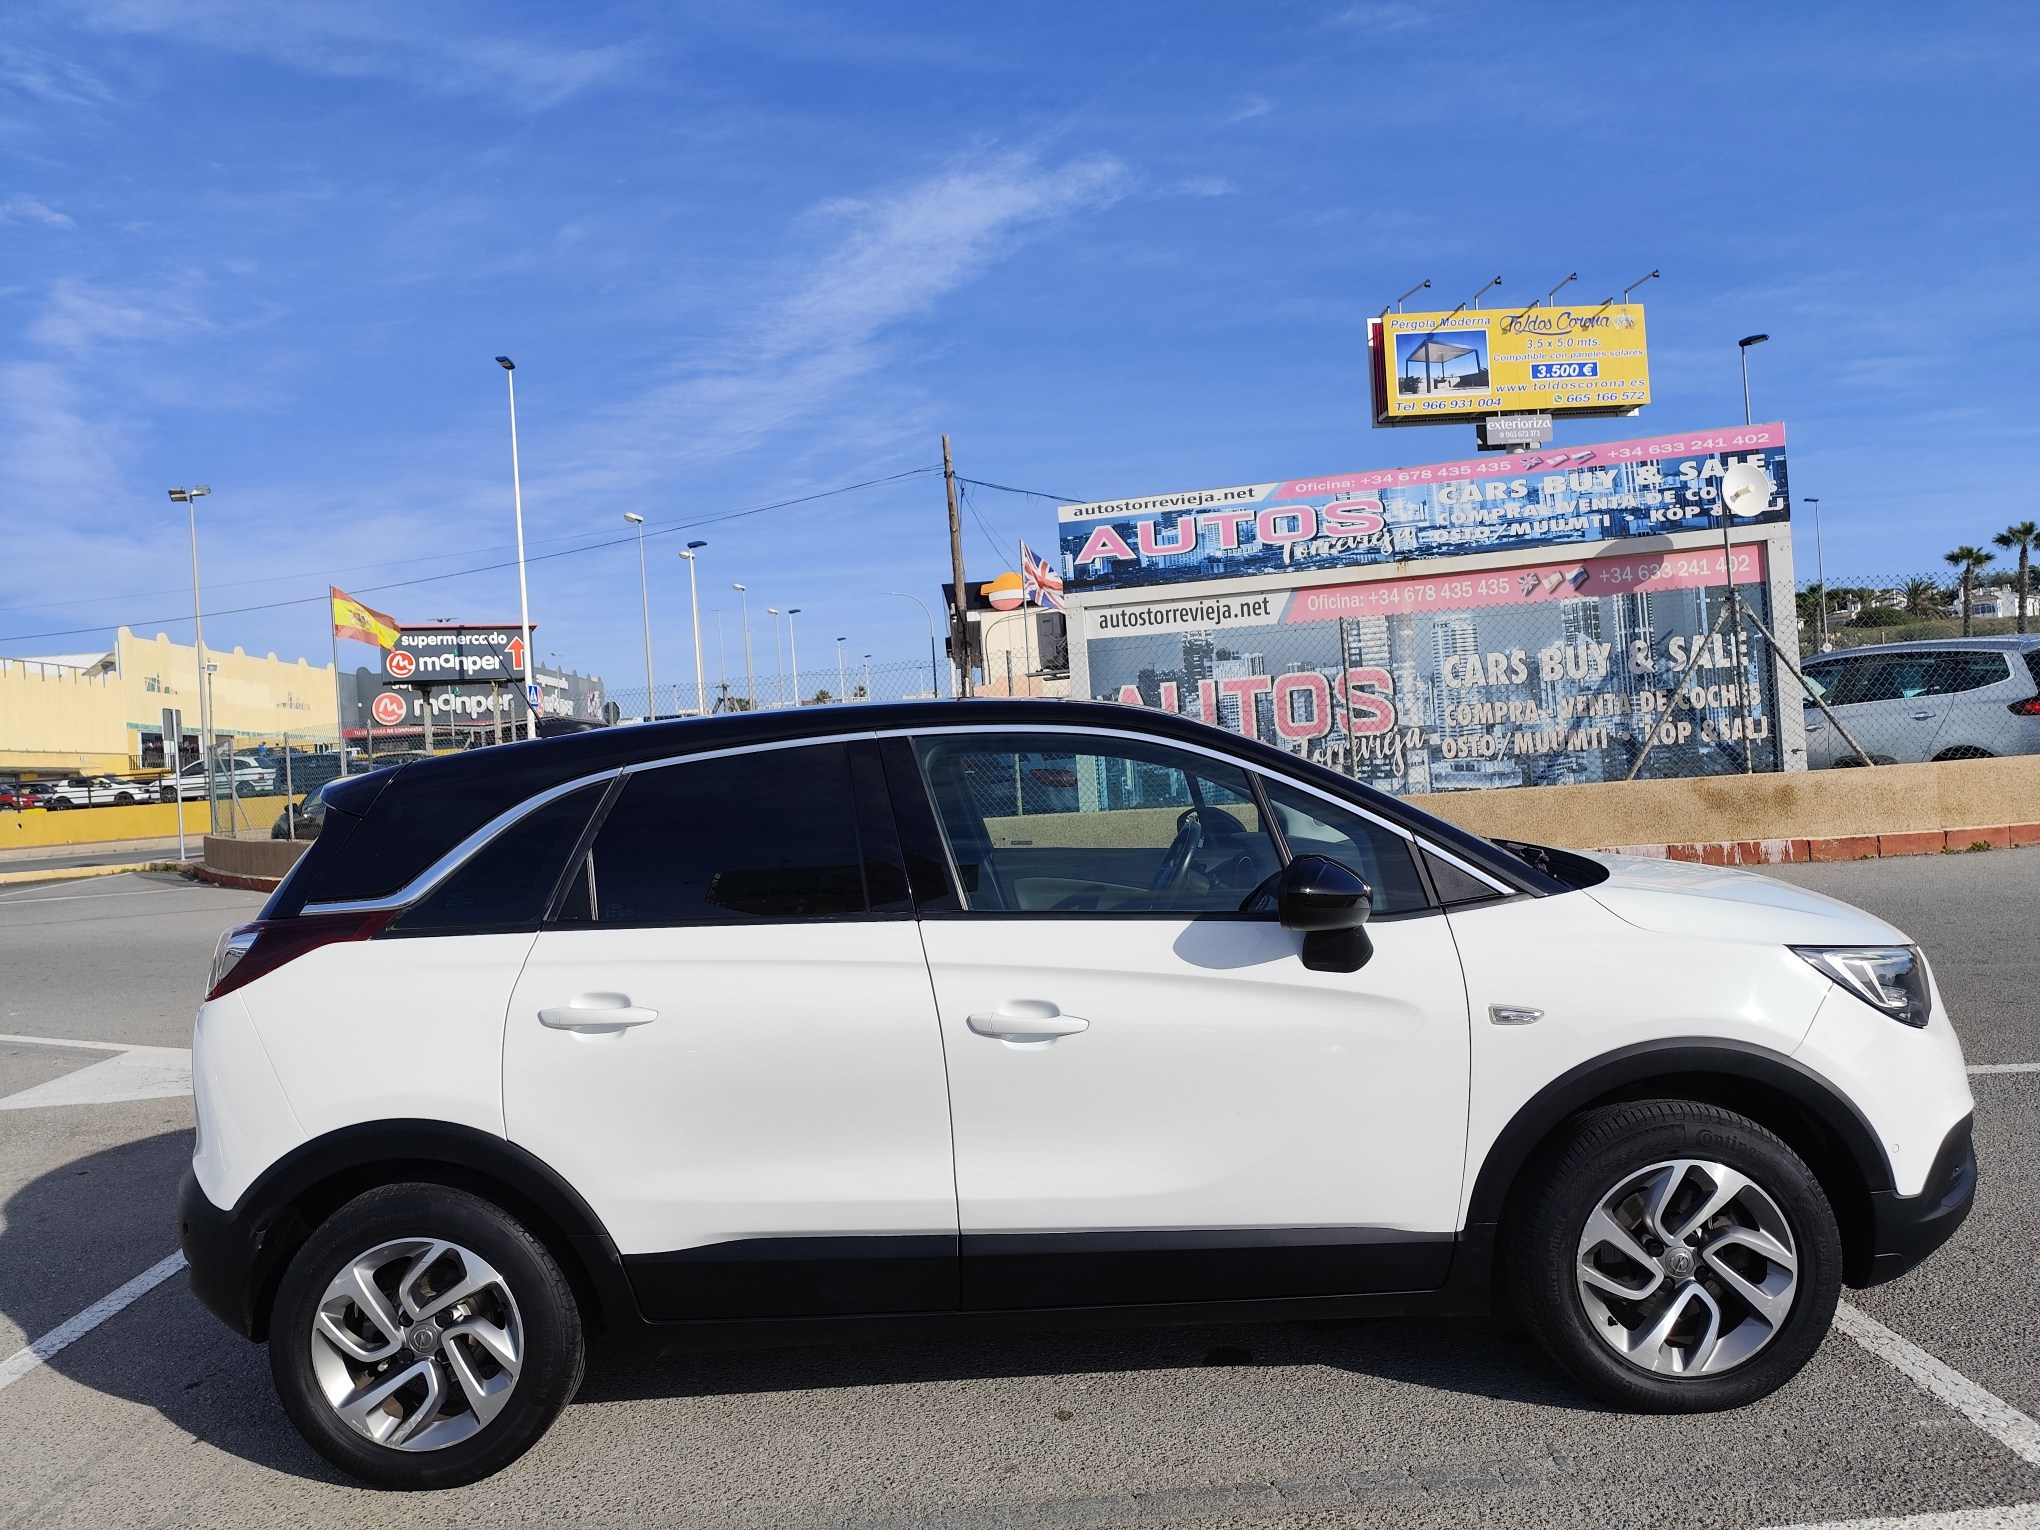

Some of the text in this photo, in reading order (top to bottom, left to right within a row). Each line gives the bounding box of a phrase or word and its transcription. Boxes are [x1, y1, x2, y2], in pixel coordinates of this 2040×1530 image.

[1440, 317, 1491, 327] Moderna
[1527, 338, 1601, 349] 3,5 x 5,0 mts.
[1493, 352, 1547, 361] Compatible
[1570, 350, 1606, 360] paneles
[1609, 348, 1643, 357] solares
[1537, 364, 1594, 377] 3.500 €
[1496, 380, 1645, 393] www.toldoscorona.es
[1395, 397, 1502, 412] Tel. 966 931 004
[1566, 391, 1645, 403] 665 166 572
[1487, 418, 1552, 430] exterioriza
[1073, 433, 1770, 517] autostorrevieja.net Oficina: +34 678 435 435 +34 633 241 402
[1438, 479, 1528, 504] CARS
[1543, 469, 1619, 494] BUY
[1636, 466, 1664, 485] &
[1437, 481, 1778, 525] COMPRA VENTA DE COS
[1651, 504, 1701, 522] KÖP
[1073, 498, 1388, 565] AUTOS
[1099, 596, 1271, 630] autostorrevieja.net
[1307, 593, 1365, 612] Oficina:
[1368, 588, 1401, 606] +34
[1404, 584, 1436, 602] 678
[1440, 580, 1472, 599] 435
[1477, 577, 1510, 596] 435
[1599, 565, 1632, 583] +34
[1638, 561, 1673, 580] 633
[1677, 557, 1711, 576] 241
[401, 632, 507, 649] supermercado
[419, 653, 503, 675] manper
[1444, 631, 1749, 689] CARS BUY & SALE
[1445, 699, 1540, 727] COMPRA
[1562, 693, 1632, 718] VENTA
[1640, 690, 1668, 713] DE
[1702, 719, 1718, 743] &
